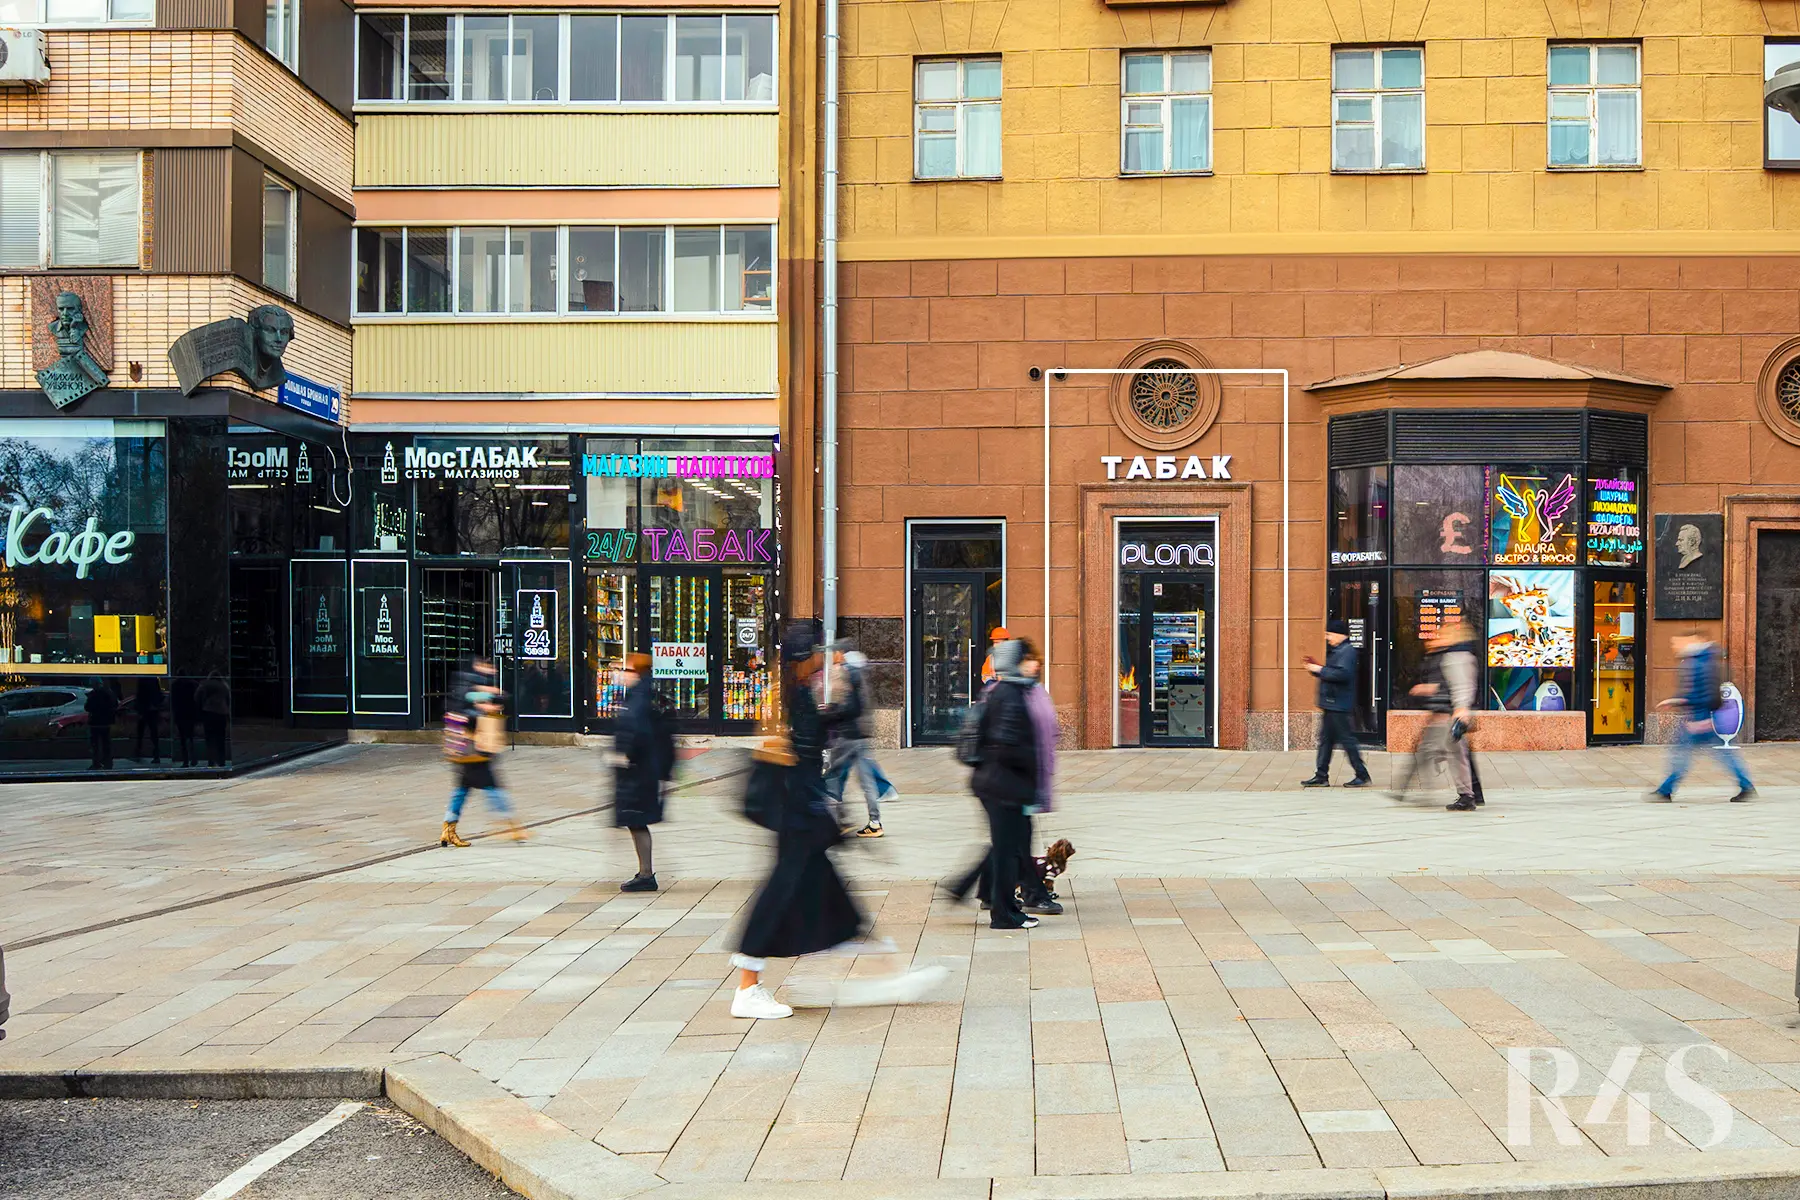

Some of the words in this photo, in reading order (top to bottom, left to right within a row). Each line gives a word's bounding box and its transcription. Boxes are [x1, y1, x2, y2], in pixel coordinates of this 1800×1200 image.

[46, 373, 83, 381] МИХАИЛ
[307, 387, 328, 406] БРОННАЯ
[331, 396, 339, 415] 29
[405, 446, 540, 468] МосТАБАК
[582, 453, 668, 478] МАГАЗИН
[675, 455, 775, 479] НАПИТКОВ
[1101, 455, 1233, 480] ТАБАК
[405, 470, 436, 479] СЕТЬ
[445, 470, 520, 479] МАГАЗИНОВ
[1600, 490, 1629, 502] ШАУРМА
[6, 505, 136, 580] Кафе
[587, 528, 638, 562] 24/7
[642, 529, 772, 562] ТАБАК
[1514, 543, 1557, 554] NAURA
[1341, 551, 1383, 562] ФОРАБАНК
[1495, 554, 1530, 563] БЫСТРО
[1532, 554, 1540, 563] &
[1541, 554, 1576, 563] ВКУСНО
[375, 635, 394, 643] Мос
[524, 629, 551, 647] 24
[370, 644, 399, 654] ТАБАК
[654, 646, 691, 657] ТАБАК
[693, 646, 706, 657] 24
[675, 658, 684, 668] &
[654, 668, 706, 676] ЭЛЕКТРОНКИ
